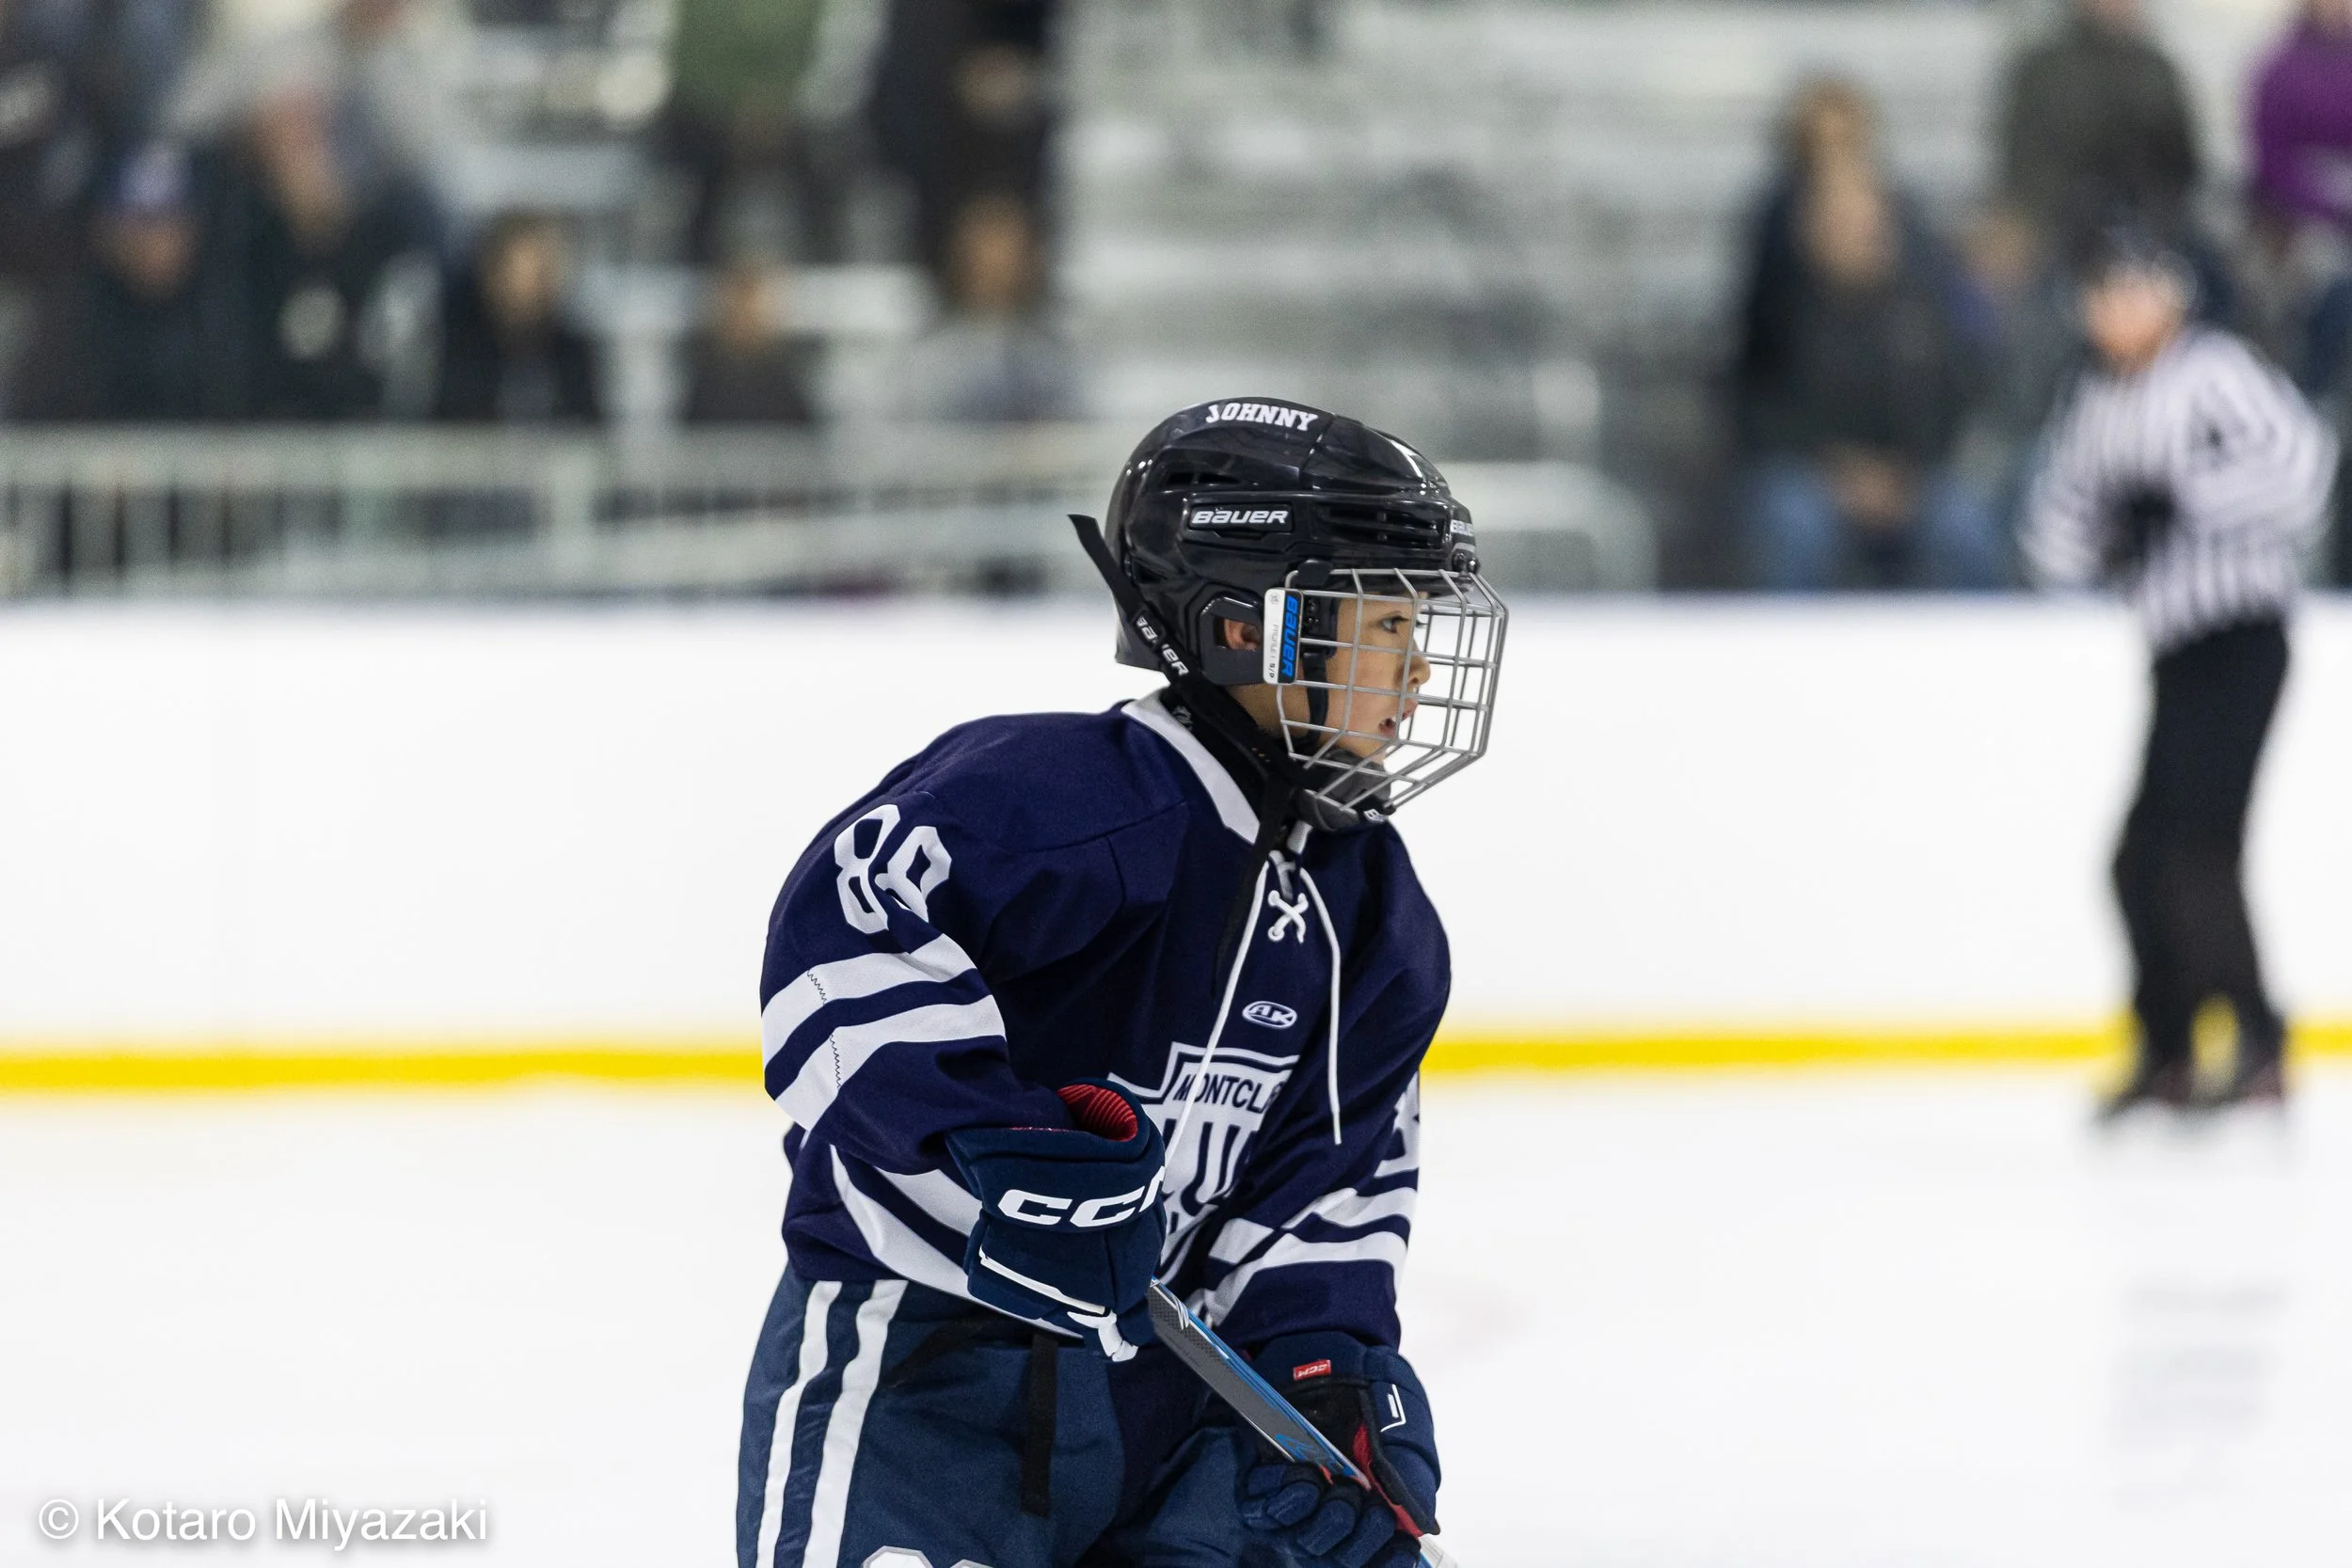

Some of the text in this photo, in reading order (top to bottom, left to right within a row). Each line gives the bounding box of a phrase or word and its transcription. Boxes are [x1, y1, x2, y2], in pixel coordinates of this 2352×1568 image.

[1205, 402, 1319, 432] JOHNNY
[1191, 510, 1289, 524] BAUER
[1136, 615, 1189, 676] BAER
[1281, 594, 1299, 677] BAUER
